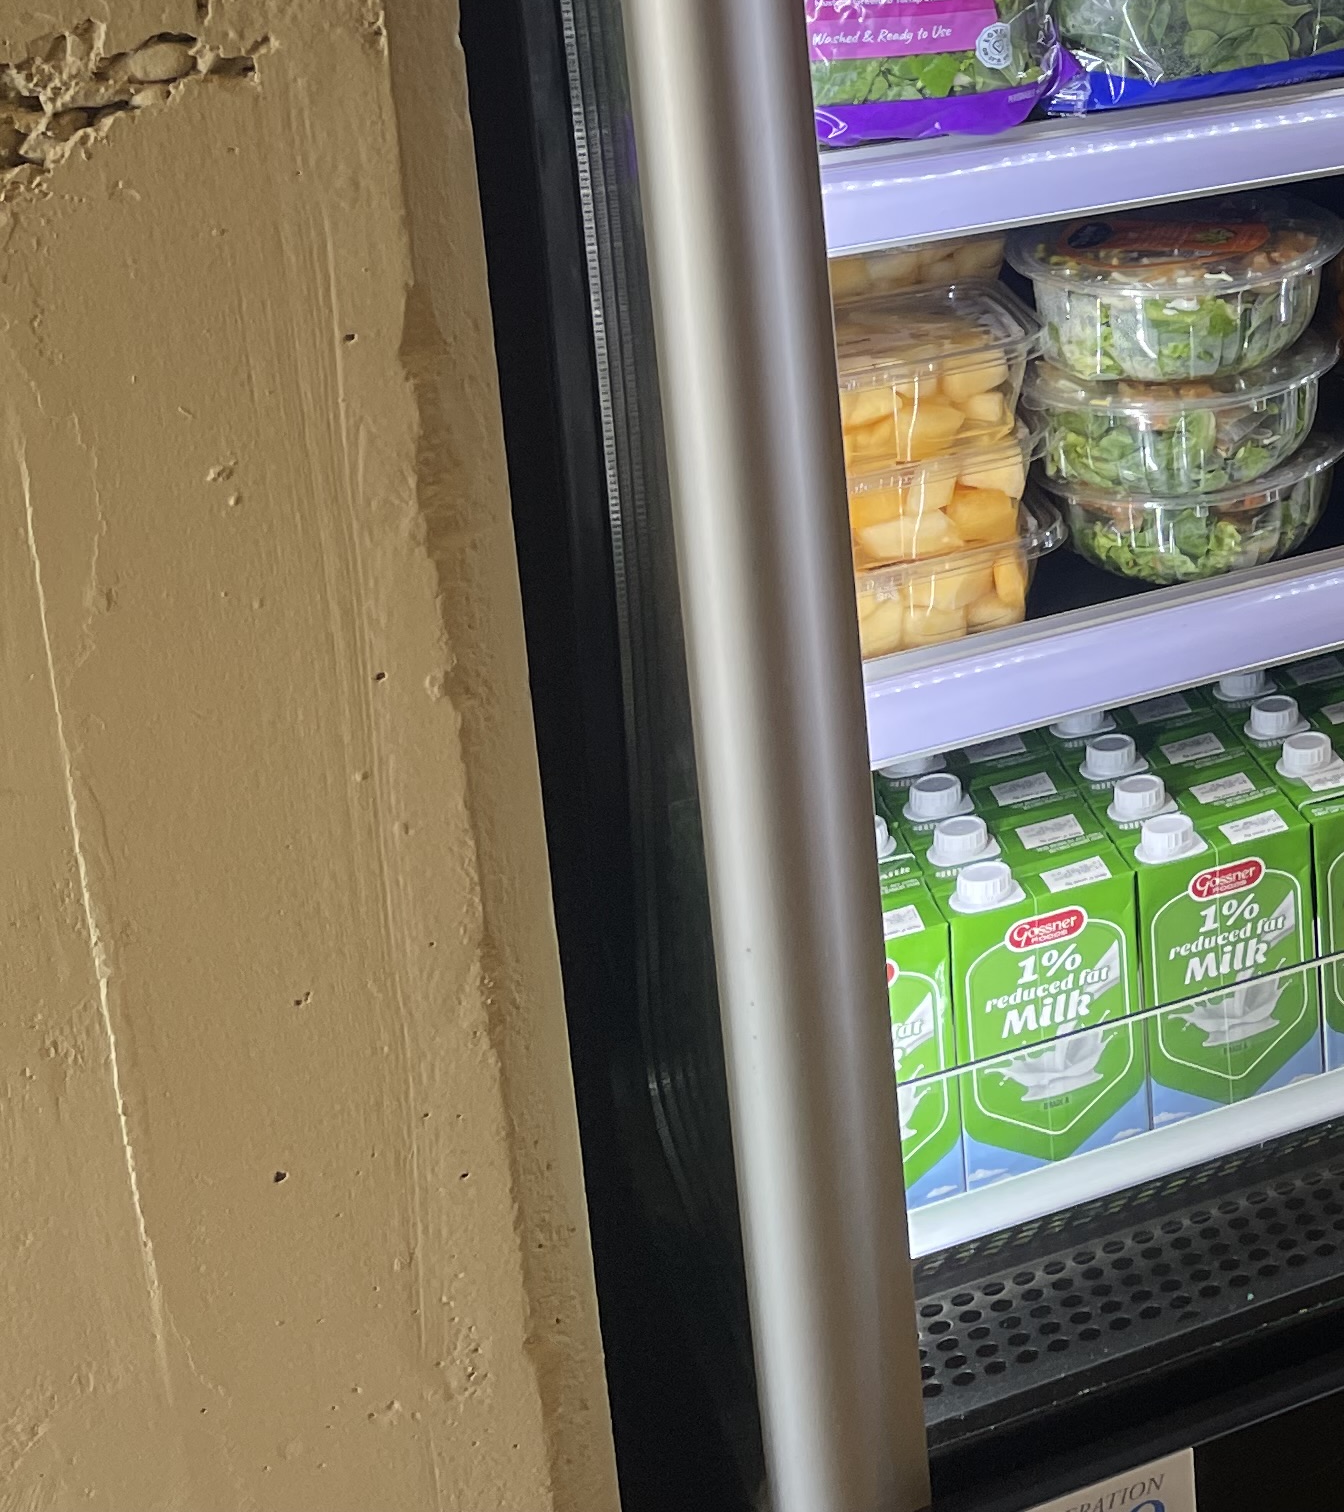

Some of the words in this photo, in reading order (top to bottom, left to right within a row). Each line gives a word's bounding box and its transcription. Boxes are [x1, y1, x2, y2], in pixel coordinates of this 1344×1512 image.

[812, 31, 859, 46] Washed
[863, 31, 875, 44] &
[878, 28, 914, 45] Ready
[917, 27, 929, 39] to
[931, 25, 953, 38] Use
[1196, 864, 1257, 897] Gossner
[1013, 915, 1078, 948] Gossner
[1198, 893, 1260, 933] 1%
[1168, 924, 1251, 961] reduced
[1256, 915, 1287, 935] fat
[1017, 943, 1083, 986] 1%
[1184, 937, 1269, 985] Milk
[985, 976, 1075, 1014] reduced
[1078, 965, 1111, 987] fat
[1001, 989, 1092, 1039] Milk
